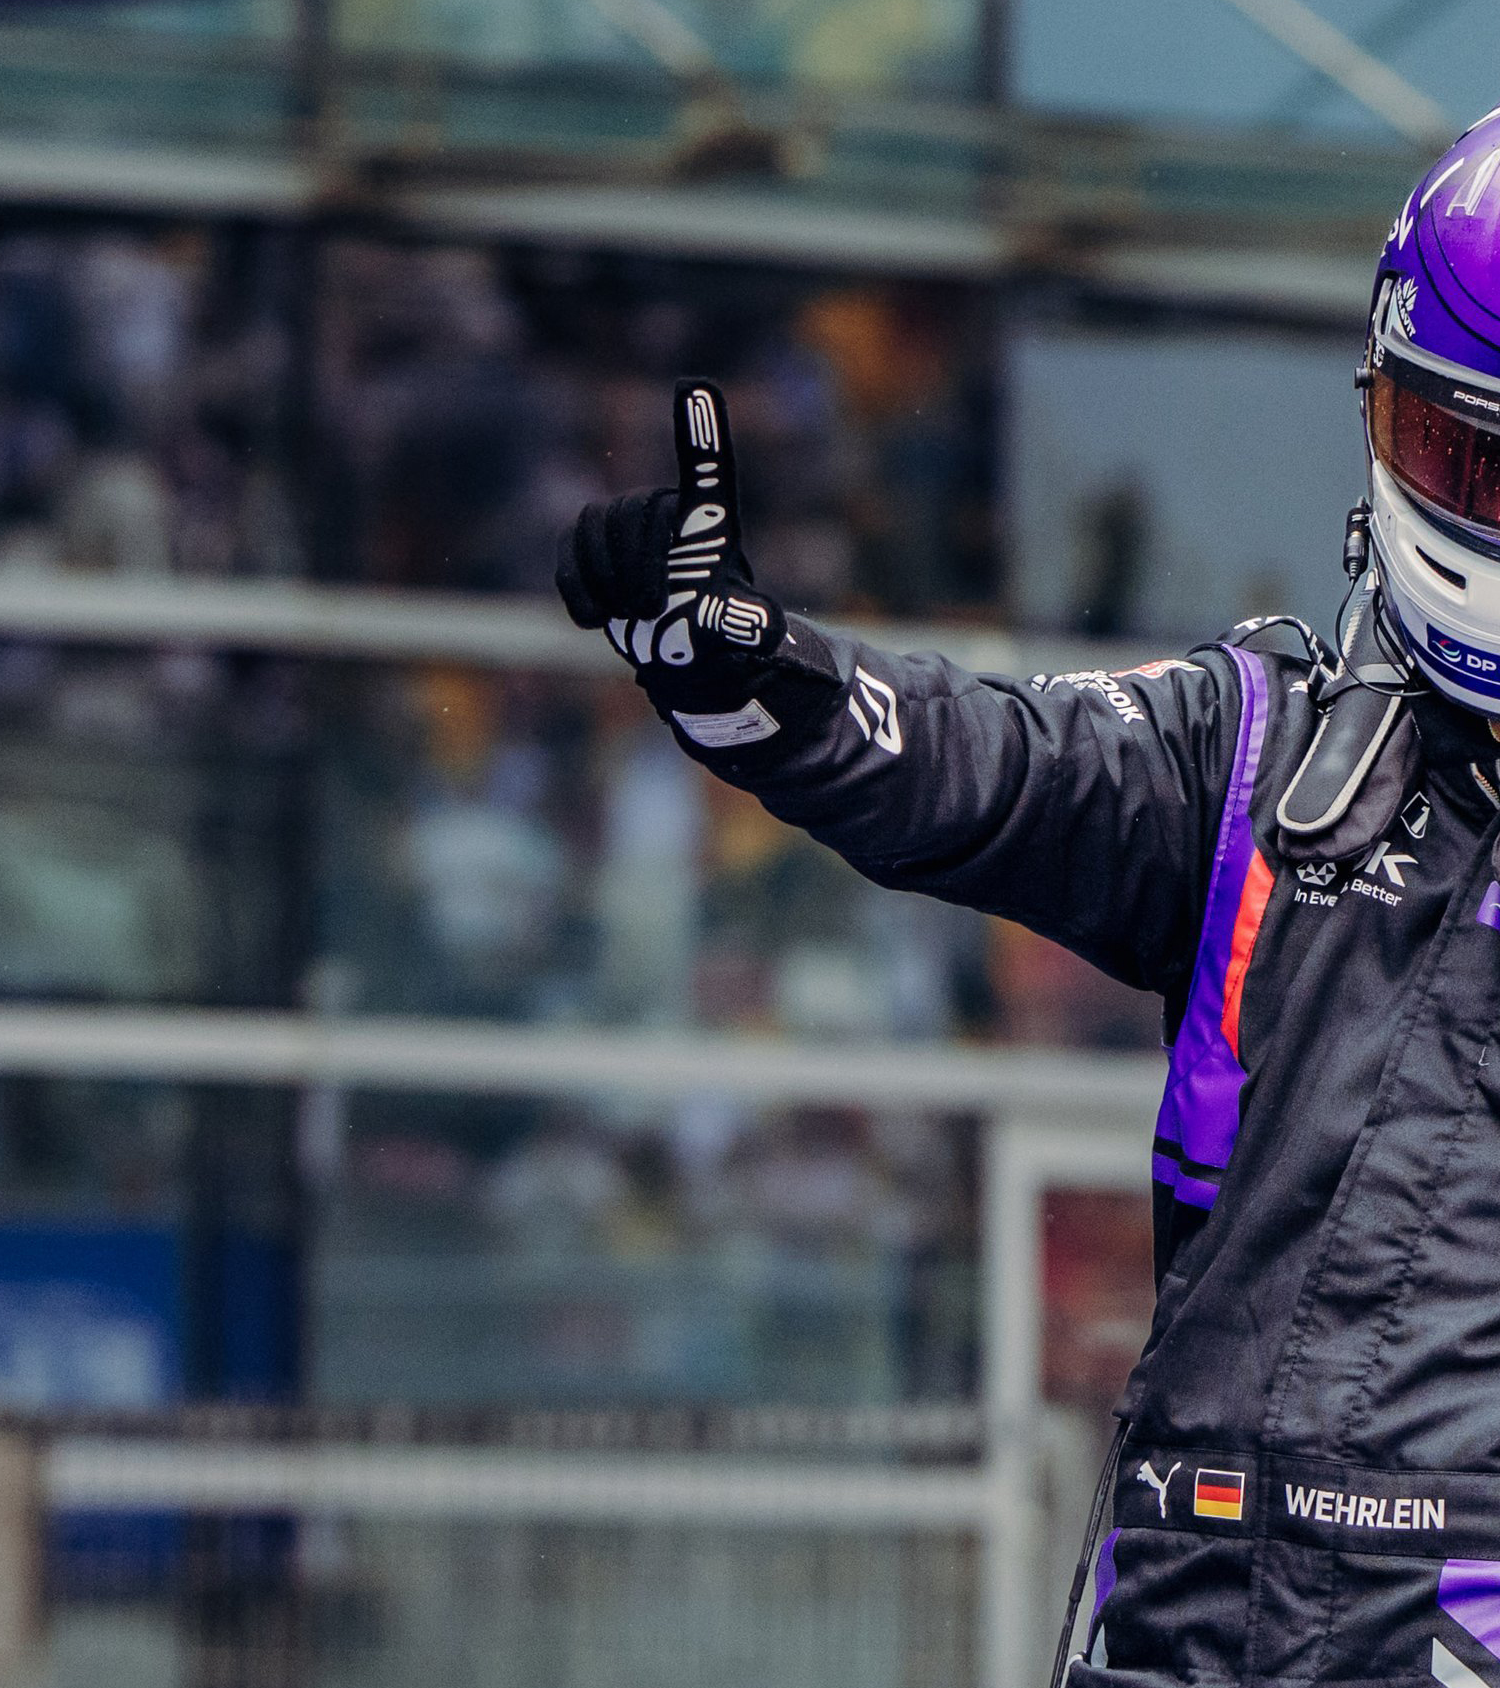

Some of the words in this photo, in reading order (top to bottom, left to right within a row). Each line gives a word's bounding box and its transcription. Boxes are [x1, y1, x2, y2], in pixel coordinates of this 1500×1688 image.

[1466, 653, 1497, 672] DP
[1294, 888, 1308, 903] In
[1350, 878, 1403, 907] Better
[1284, 1483, 1446, 1530] WEHRLEIN
